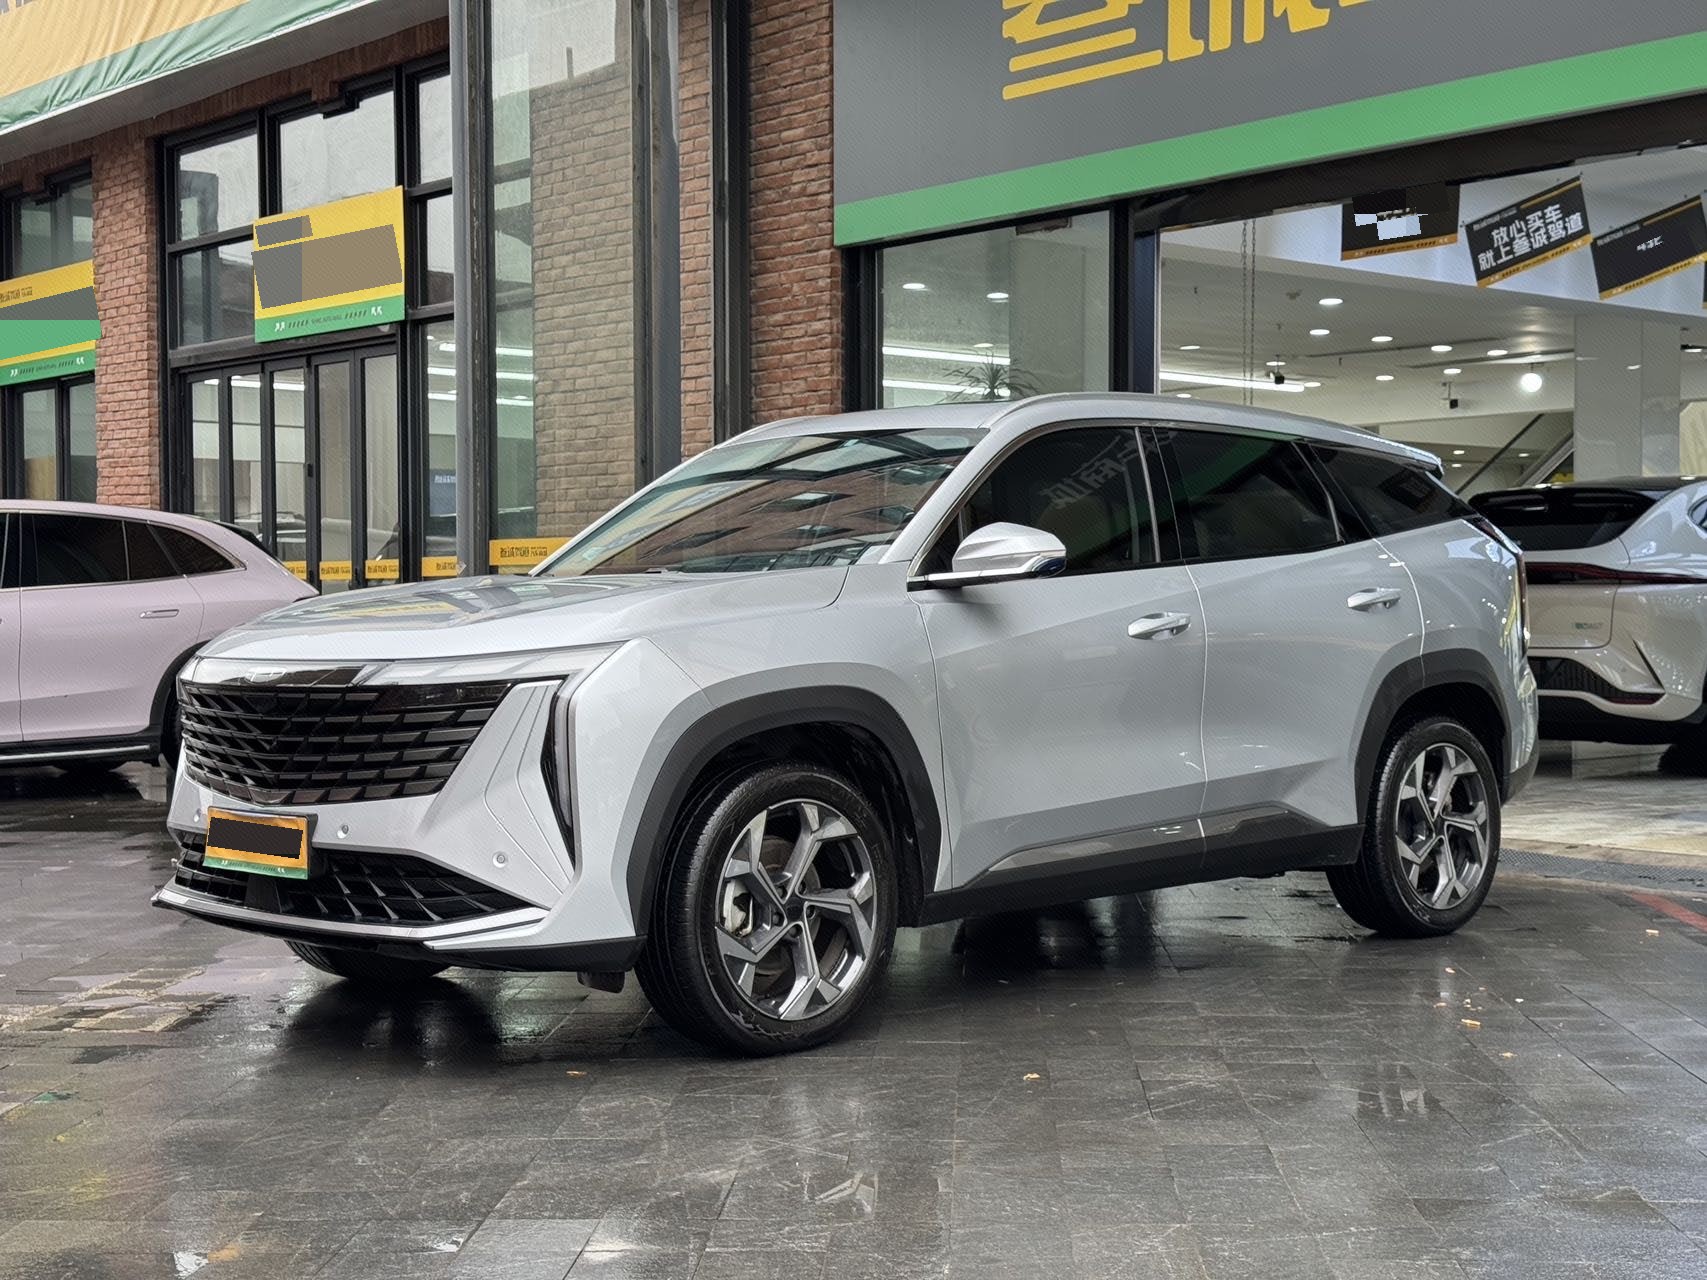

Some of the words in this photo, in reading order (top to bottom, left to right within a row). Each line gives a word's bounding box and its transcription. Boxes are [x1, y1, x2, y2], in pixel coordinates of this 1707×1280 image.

[1477, 212, 1584, 271] 就上叁诚驾道
[1491, 204, 1563, 247] 放心买车
